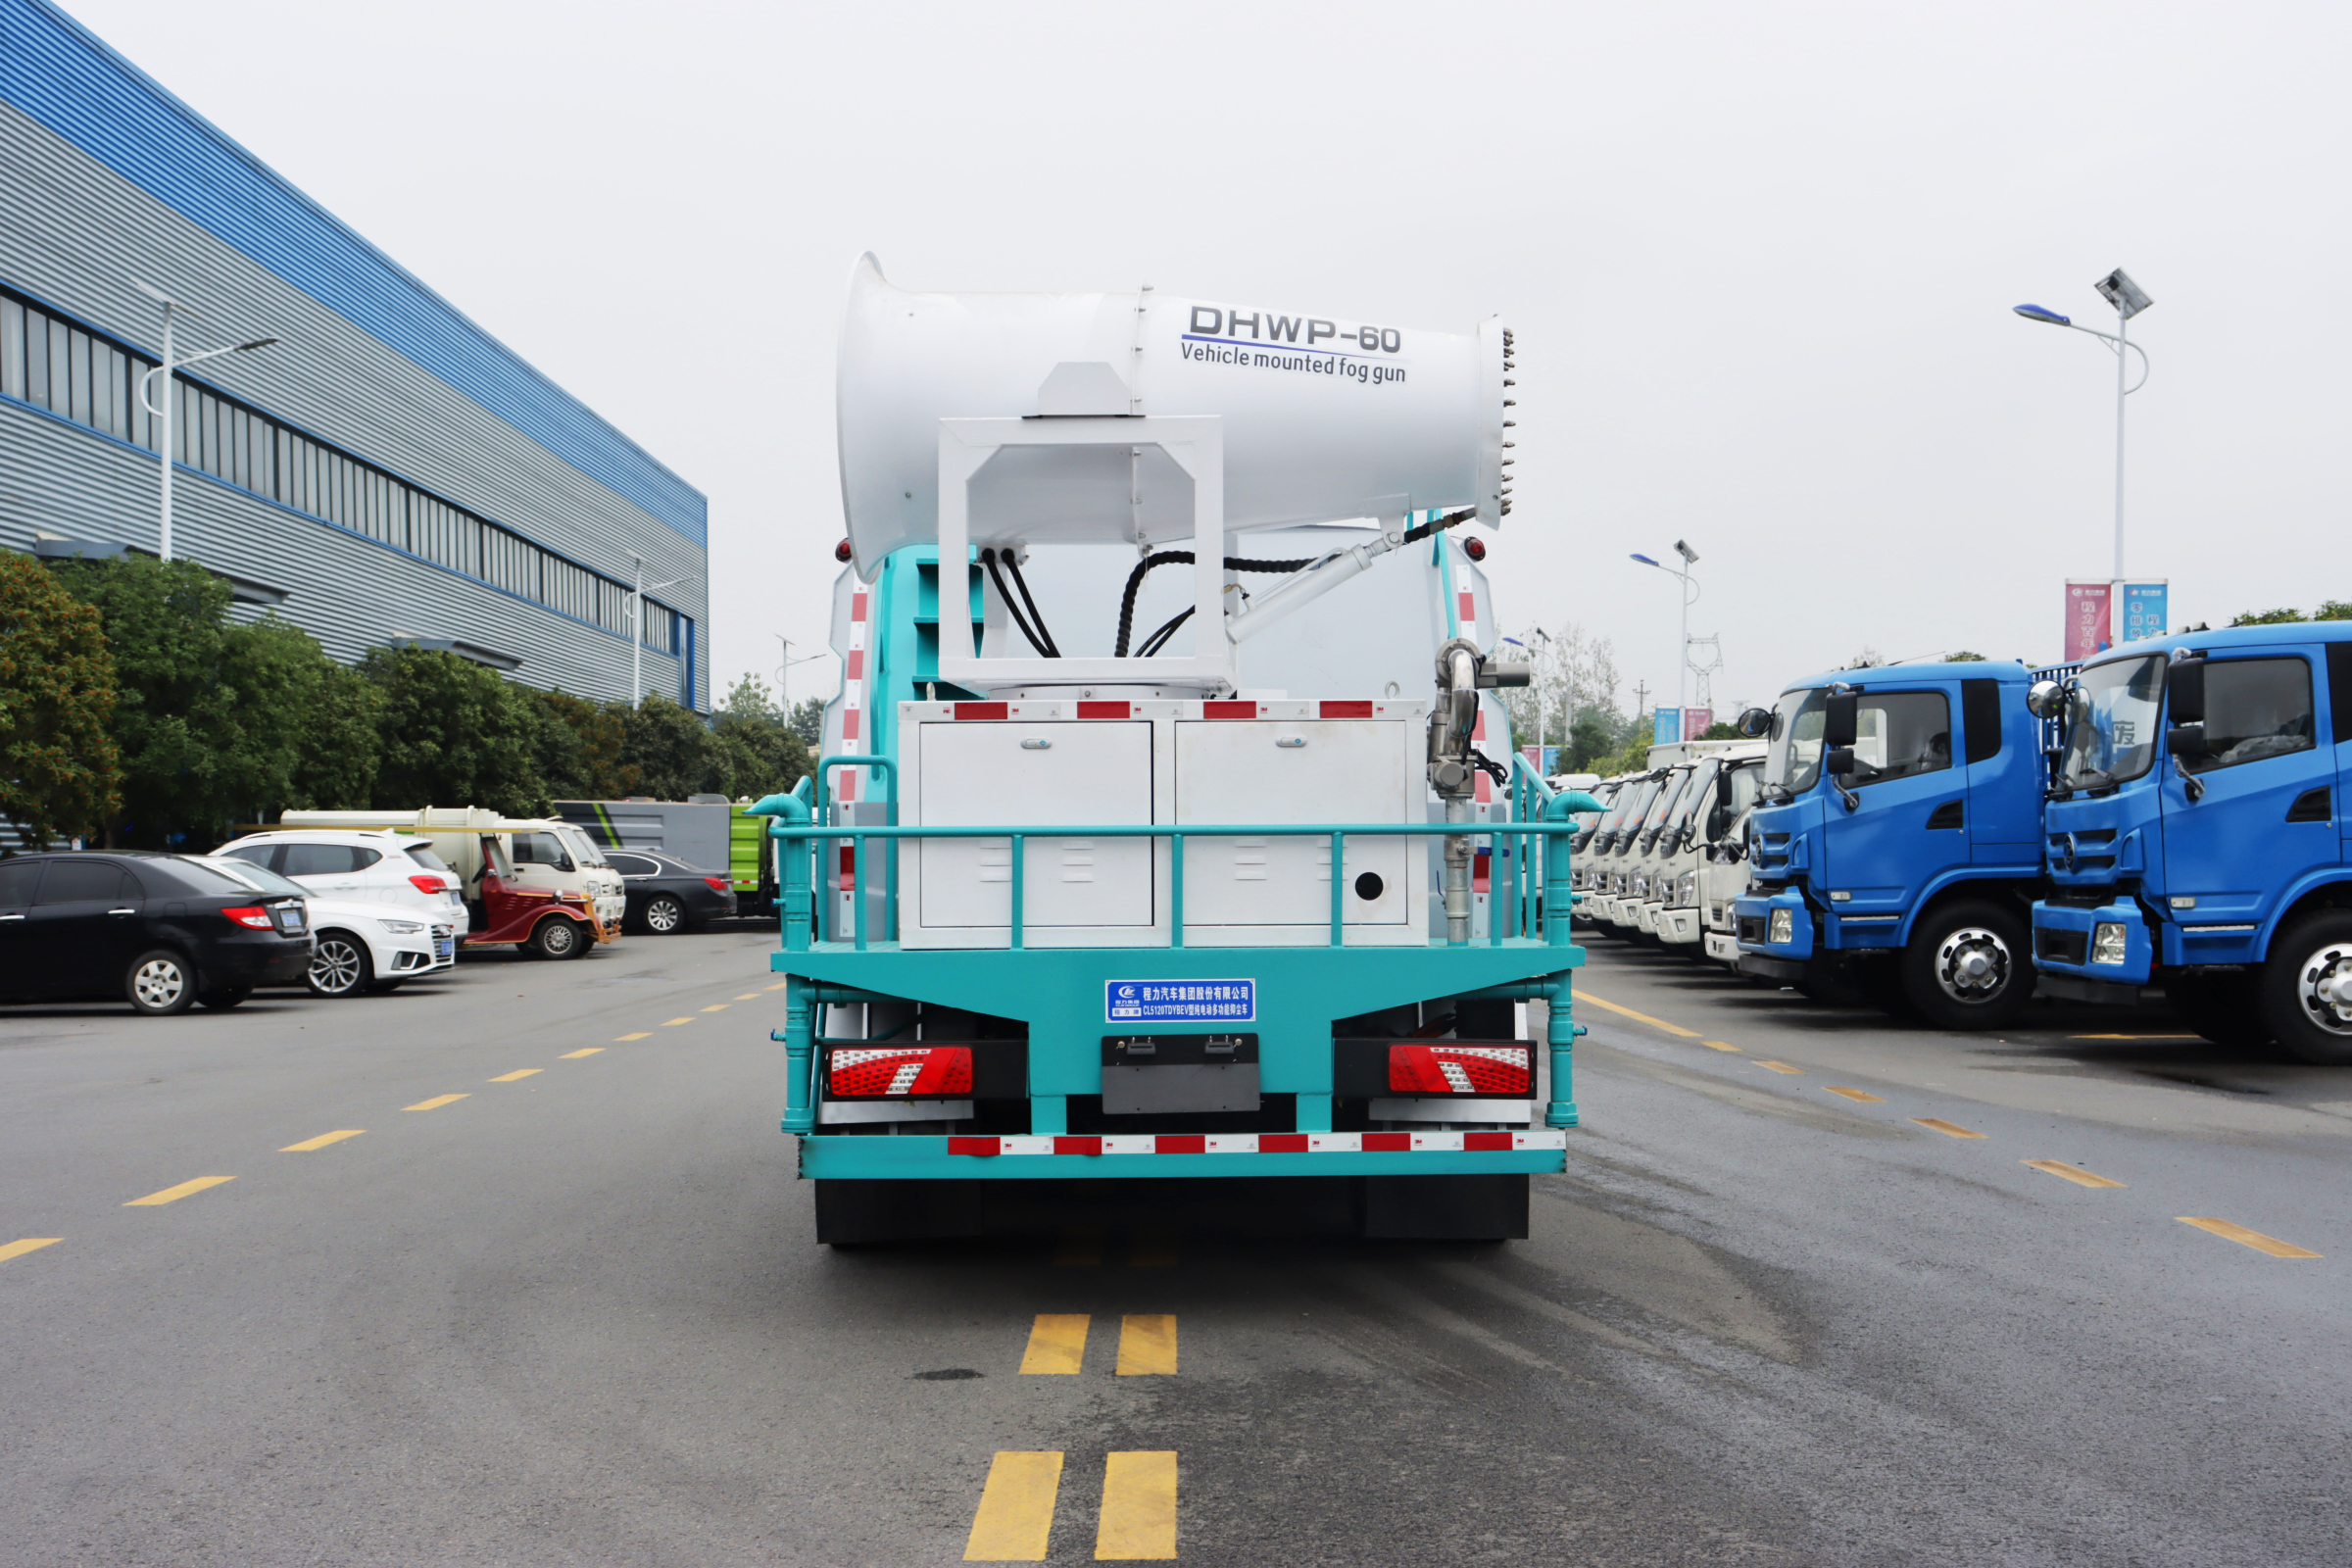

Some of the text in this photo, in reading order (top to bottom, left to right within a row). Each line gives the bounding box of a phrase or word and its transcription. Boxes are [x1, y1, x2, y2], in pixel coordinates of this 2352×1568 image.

[1190, 306, 1401, 354] DHWP-60
[1181, 342, 1405, 384] Vehicle mounted fog gun
[1143, 986, 1249, 1001] 程力汽车集团股份有限公司
